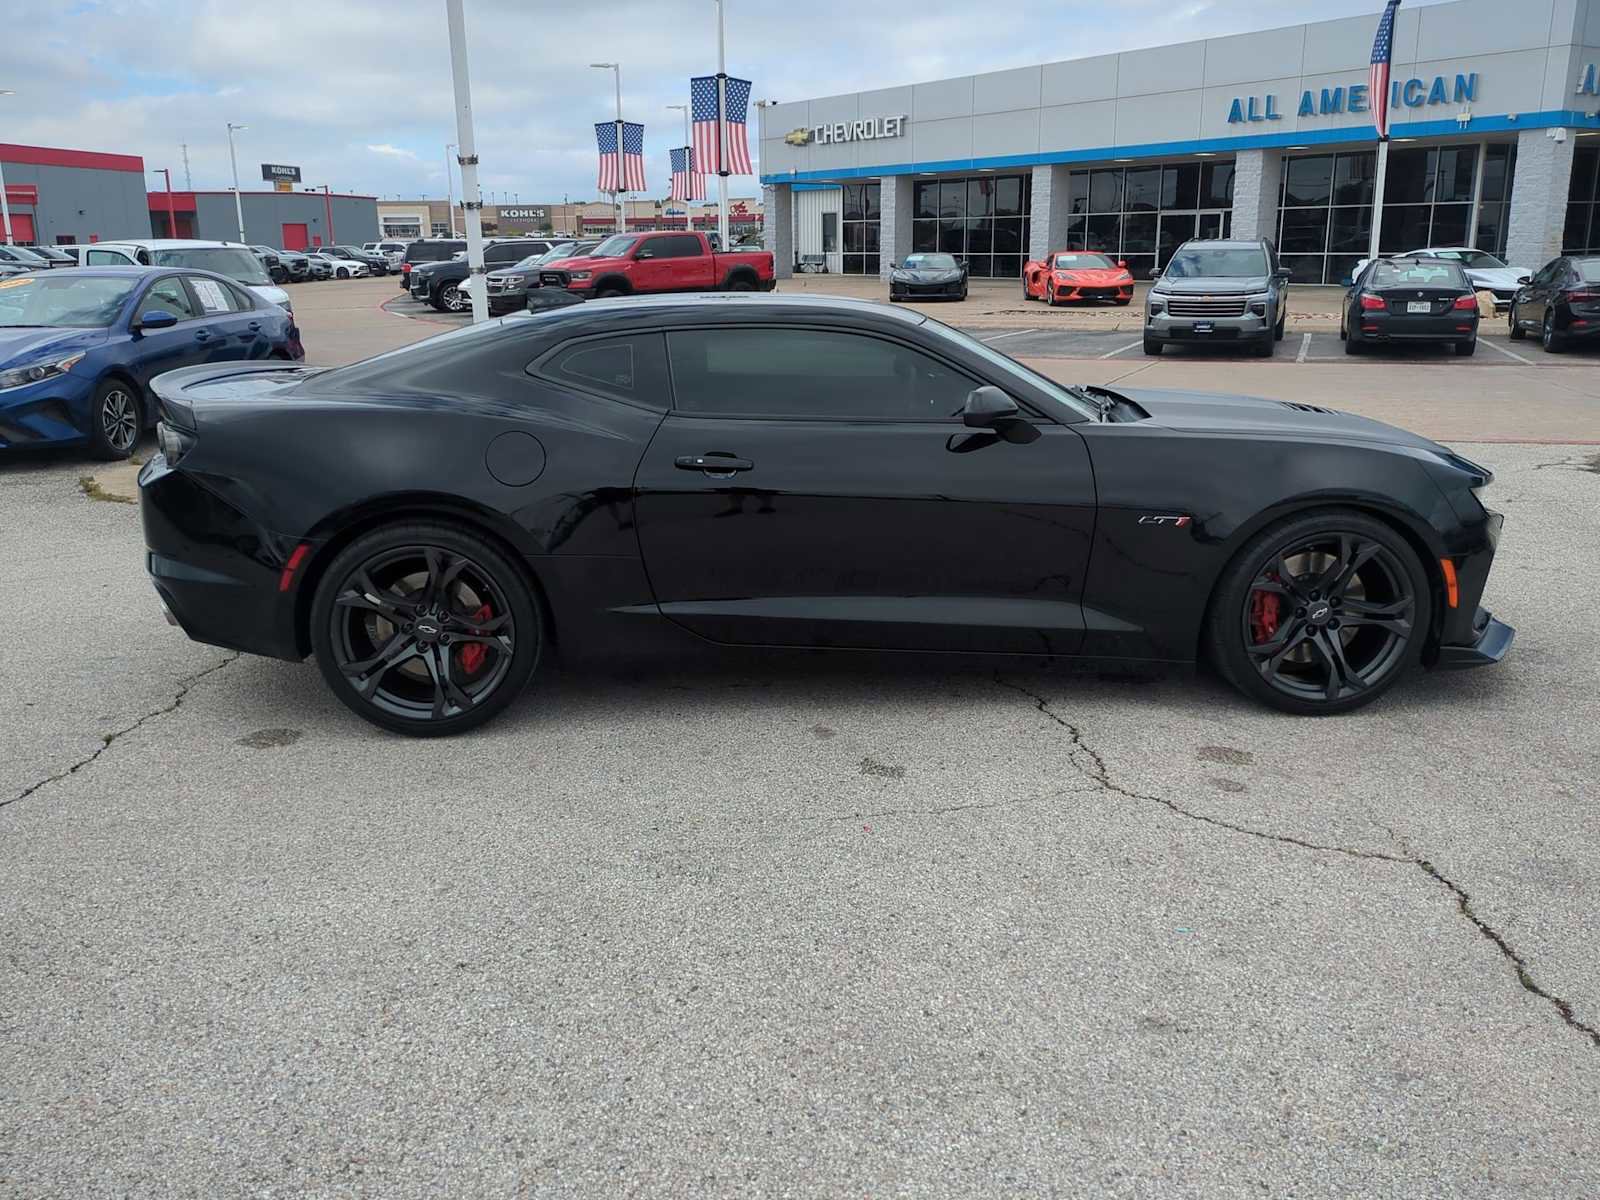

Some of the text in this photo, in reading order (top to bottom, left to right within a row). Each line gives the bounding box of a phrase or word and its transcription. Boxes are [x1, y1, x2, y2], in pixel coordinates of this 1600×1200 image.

[1228, 72, 1478, 124] ALL AMEICAN
[814, 115, 906, 145] CHEVROLET
[500, 208, 545, 218] KOHL'S
